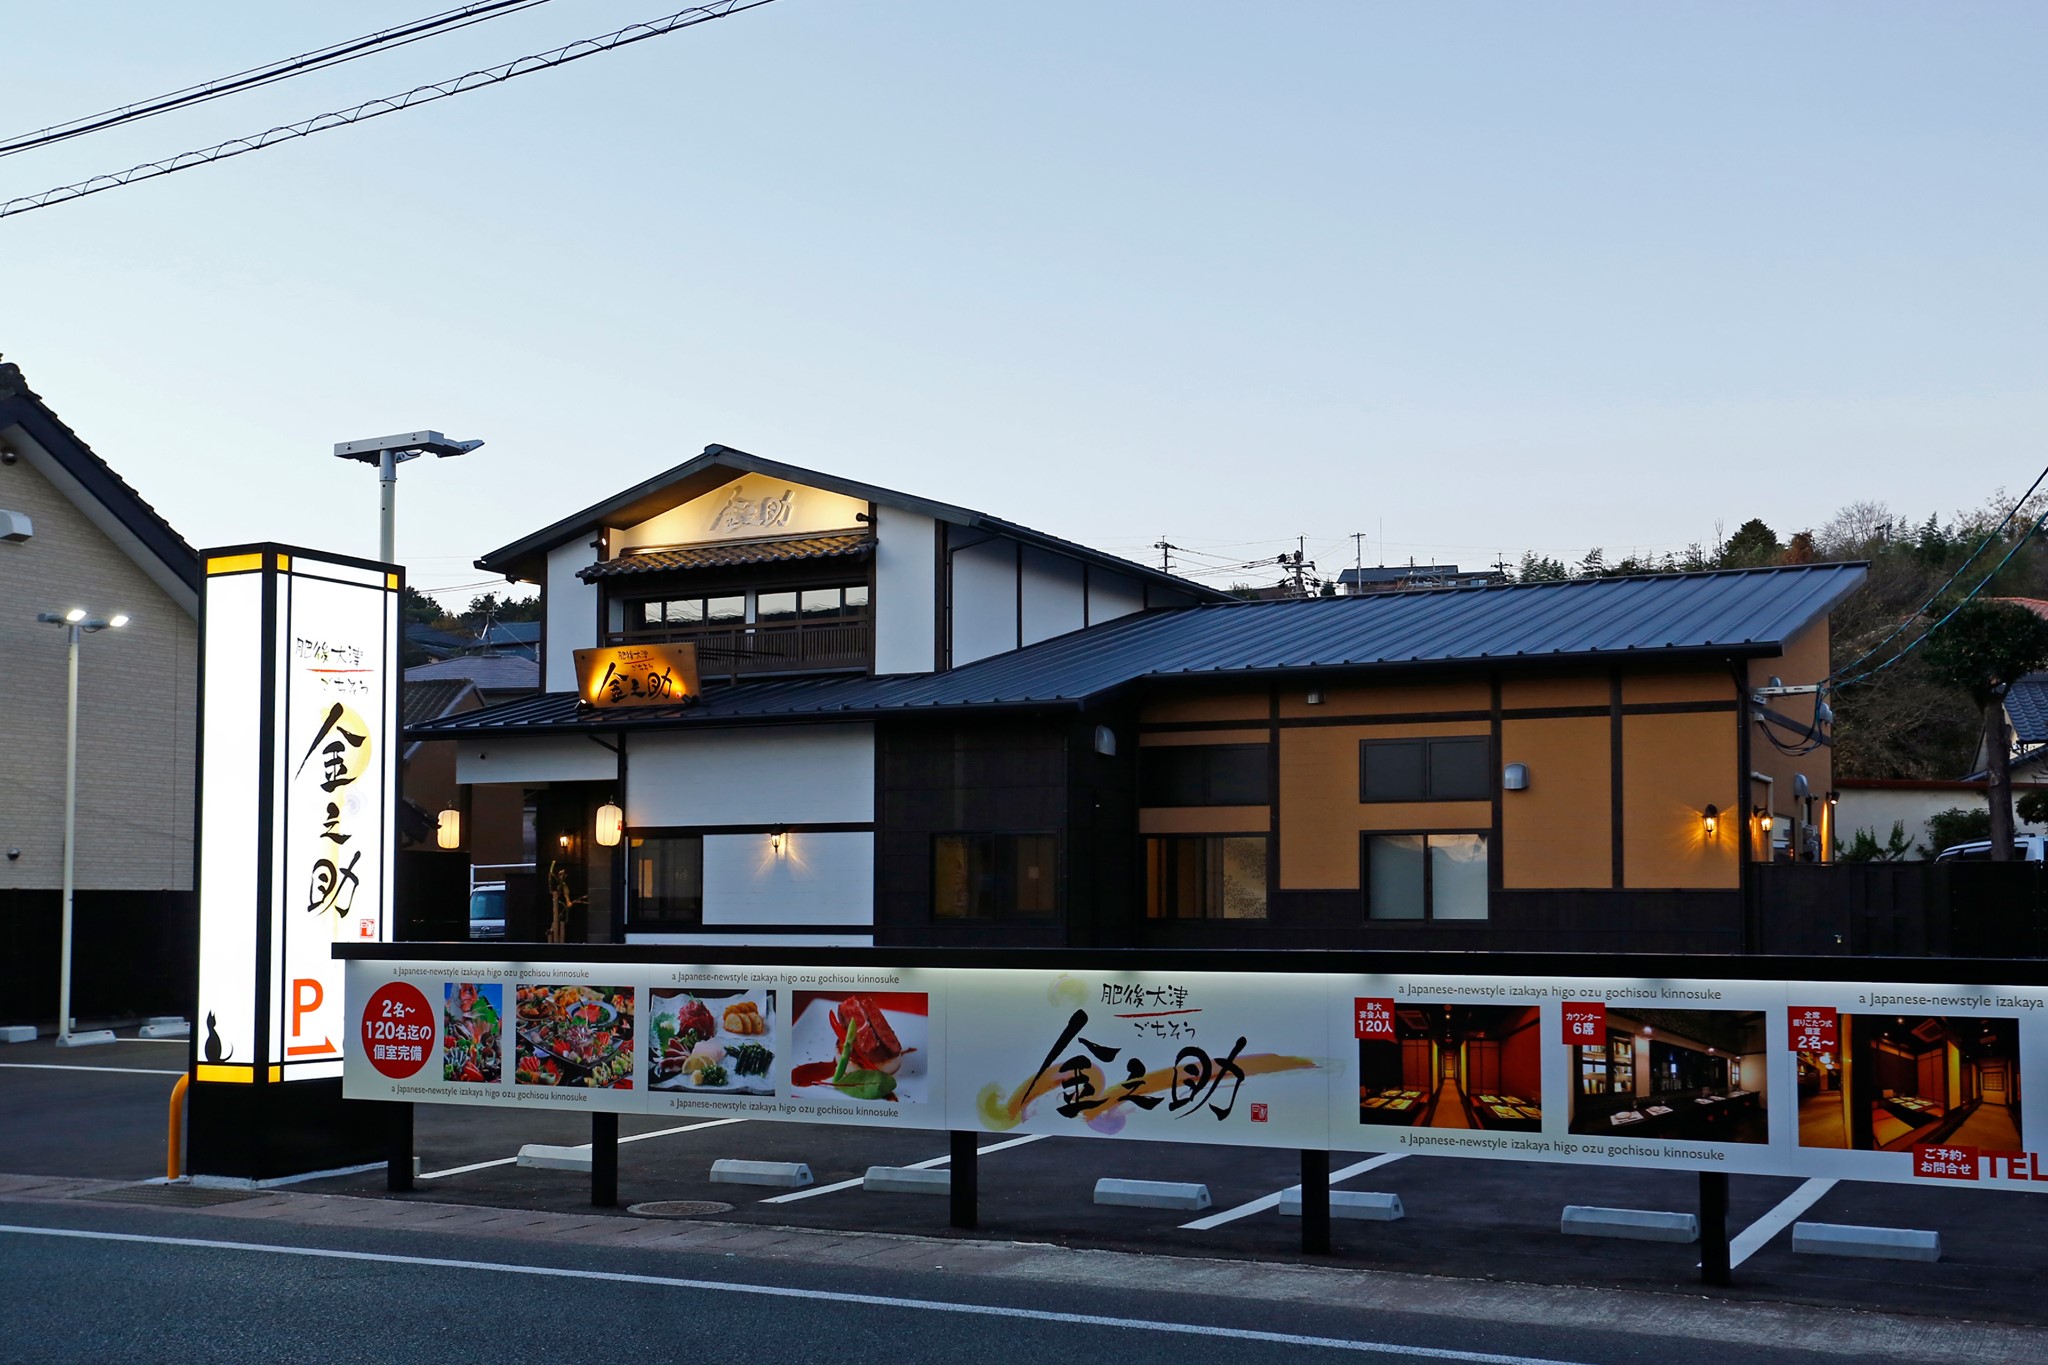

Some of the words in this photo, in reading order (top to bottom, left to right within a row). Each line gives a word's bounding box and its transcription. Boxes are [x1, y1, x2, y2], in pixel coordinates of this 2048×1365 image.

[597, 662, 673, 703] 金之助
[294, 702, 367, 918] 金之助
[398, 966, 459, 978] Japanese-newstyle
[460, 968, 485, 978] izakaya
[487, 968, 502, 978] higo
[519, 969, 550, 979] gochisou
[552, 969, 590, 978] kinnosuke
[677, 972, 748, 984] Japanese-newstyle
[750, 973, 778, 985] izakaya
[780, 973, 798, 985] higo
[818, 974, 854, 985] gochisou
[857, 974, 900, 984] kinnosuke
[1100, 983, 1189, 1009] 肥後大津
[1398, 985, 1404, 994] a
[1407, 983, 1506, 999] Japanese-newstyle
[1509, 985, 1548, 1000] izakaya
[1551, 985, 1576, 1000] higo
[1579, 989, 1601, 998] ozu
[1605, 987, 1657, 1002] gochisou
[1661, 987, 1722, 1001] kinnosuke
[1859, 994, 1866, 1004] a
[1869, 992, 1991, 1009] Japanese-newstyle
[1996, 995, 2045, 1010] izakaya
[292, 978, 324, 1037] P
[1565, 1012, 1602, 1021] カウンター
[366, 1021, 432, 1040] 120名迄の
[1134, 1020, 1196, 1041] ごちそう
[1358, 1020, 1393, 1033] 120人
[373, 1044, 423, 1061] 個室完備
[1020, 1008, 1248, 1121] 金之助
[396, 1084, 457, 1097] Japanese-newstyle
[459, 1087, 483, 1098] izakaya
[485, 1088, 500, 1099] higo
[517, 1089, 549, 1101] gochisou
[551, 1091, 587, 1102] kinnosuke
[676, 1098, 747, 1111] Japanese-newstyle
[749, 1102, 777, 1113] izakaya
[779, 1103, 796, 1114] higo
[816, 1105, 853, 1116] gochisou
[856, 1106, 899, 1117] kinnosuke
[1400, 1134, 1406, 1144] a
[1408, 1132, 1507, 1149] Japanese-newstyle
[1511, 1139, 1550, 1153] izakaya
[1553, 1140, 1578, 1155] higo
[1581, 1144, 1604, 1153] ozu
[1607, 1143, 1660, 1158] gochisou
[1663, 1145, 1725, 1161] kinnosuke
[1921, 1161, 1972, 1175] お問合せ
[1980, 1150, 2048, 1181] TEL
